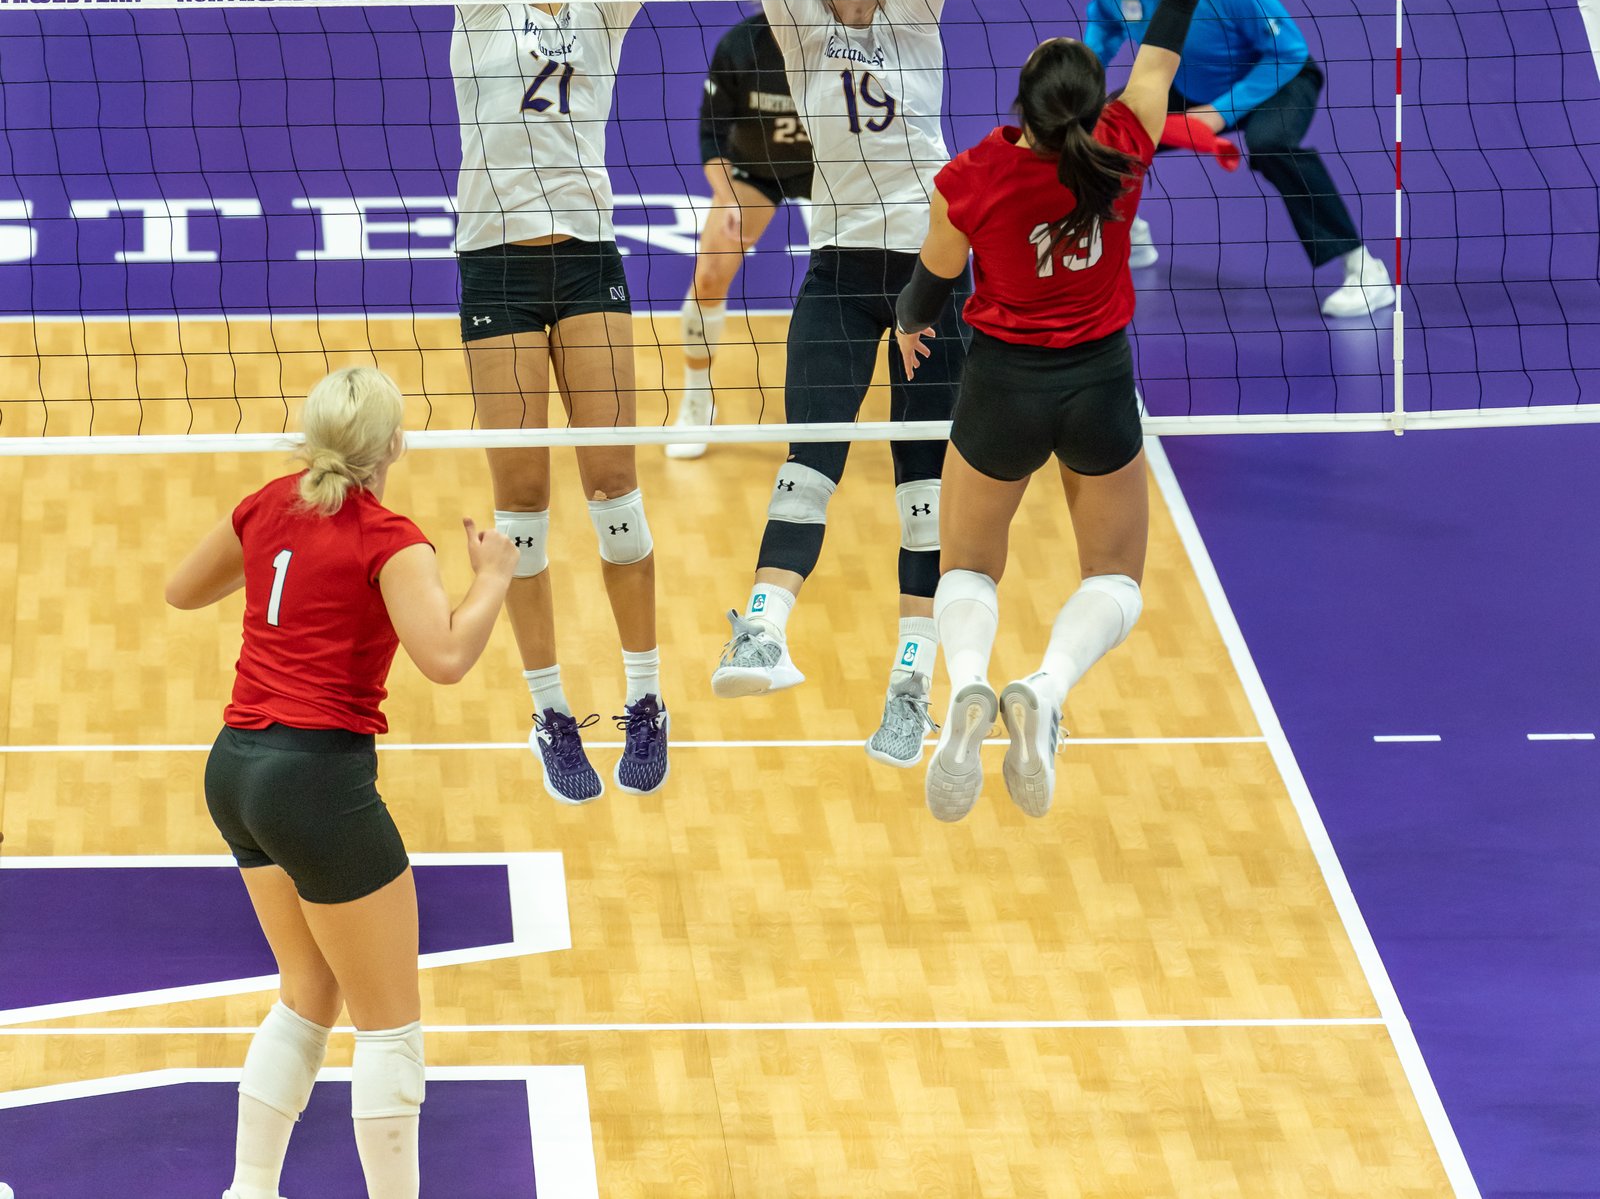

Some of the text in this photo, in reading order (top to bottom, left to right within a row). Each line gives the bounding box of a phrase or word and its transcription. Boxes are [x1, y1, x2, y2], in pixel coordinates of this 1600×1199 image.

[520, 50, 575, 115] 21
[840, 68, 896, 134] 19
[267, 548, 293, 627] 1
